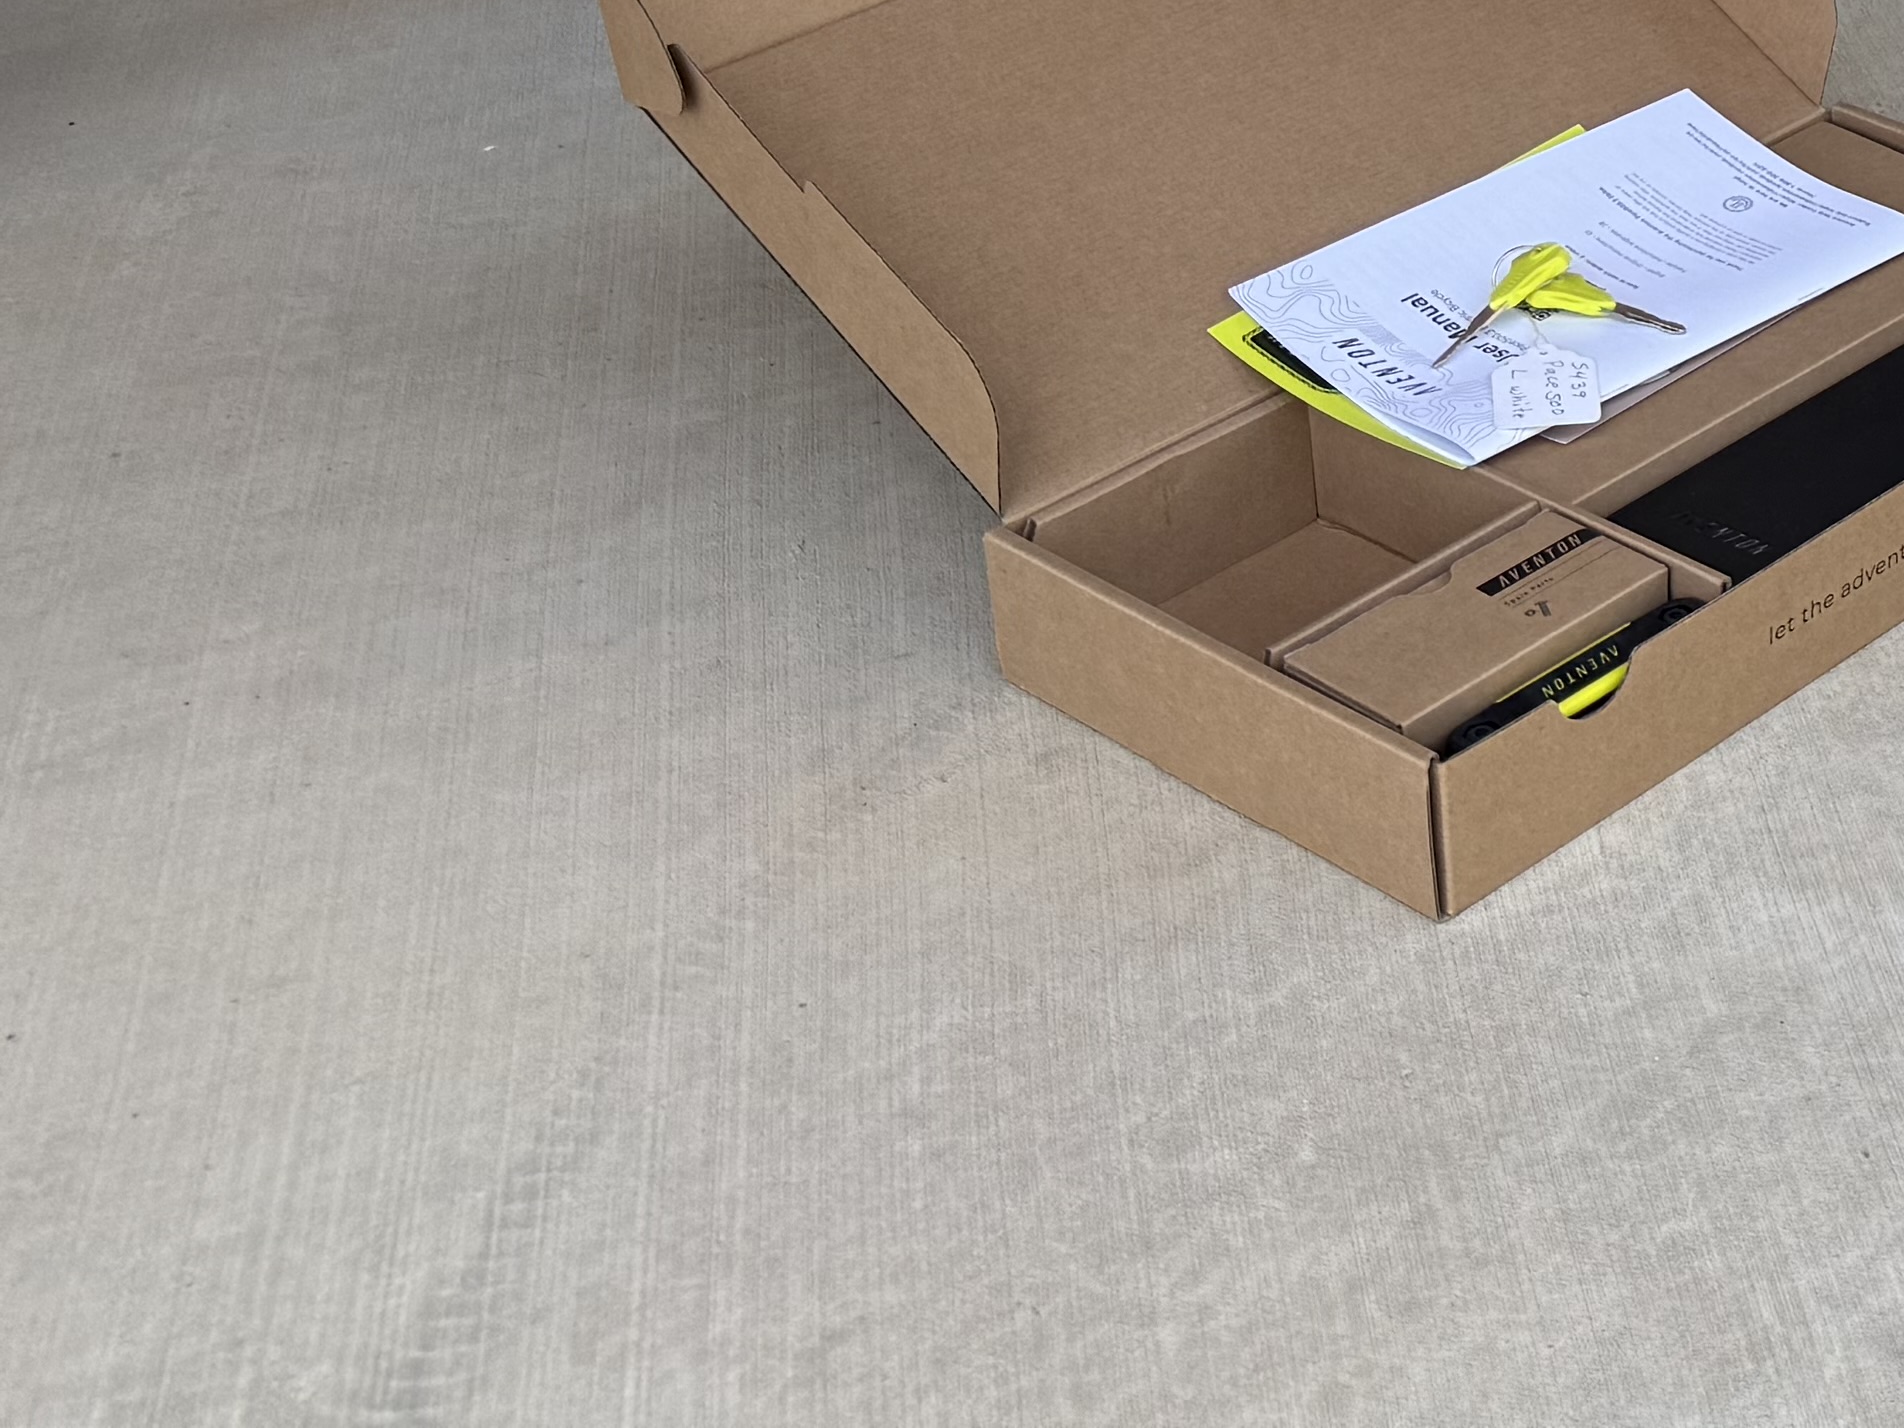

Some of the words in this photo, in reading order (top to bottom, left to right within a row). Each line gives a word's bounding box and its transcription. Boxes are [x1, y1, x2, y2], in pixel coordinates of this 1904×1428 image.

[1331, 336, 1444, 396] AVENTON
[1498, 533, 1584, 590] AVENTON
[1767, 616, 1797, 645] let
[1801, 591, 1835, 623] the
[1540, 643, 1620, 699] AVENTON
